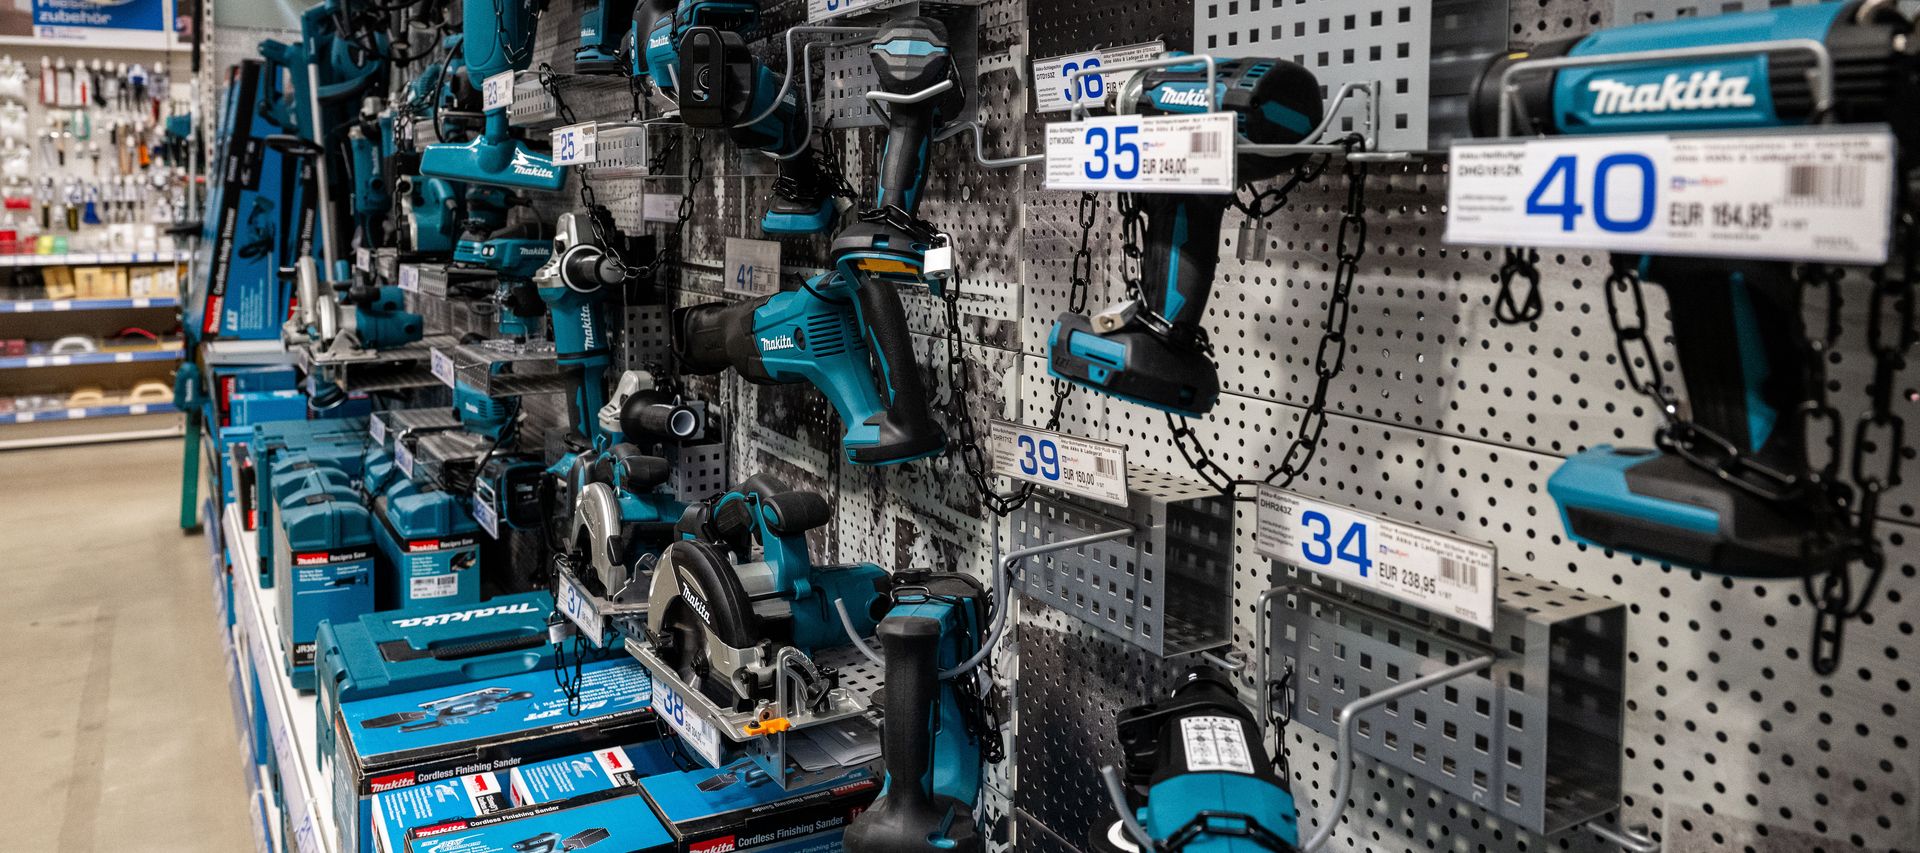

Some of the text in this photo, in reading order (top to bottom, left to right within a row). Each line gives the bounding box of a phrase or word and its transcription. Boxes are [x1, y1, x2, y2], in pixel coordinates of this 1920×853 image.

[487, 80, 498, 105] 23
[1062, 58, 1103, 101] 36
[561, 132, 575, 160] 25
[1084, 125, 1140, 180] 35
[1143, 158, 1156, 174] EUR
[1525, 153, 1658, 234] 40
[1669, 202, 1704, 227] EUR
[737, 264, 753, 291] 41
[1018, 434, 1060, 481] 39
[1063, 467, 1075, 481] EUR
[1075, 470, 1095, 486] 150,00
[1301, 510, 1373, 578] 34
[1379, 562, 1398, 582] EUR
[1402, 568, 1436, 595] 238,95
[568, 585, 582, 619] 37
[664, 683, 684, 727] 38
[418, 767, 453, 783] Cordless
[455, 760, 492, 777] Finishing
[493, 755, 521, 771] Sander
[470, 817, 501, 827] Cordless
[502, 808, 535, 820] Finishing
[535, 804, 559, 815] Sander
[737, 829, 775, 848] Cordless
[776, 822, 815, 841] Finishing
[815, 815, 844, 832] Sander
